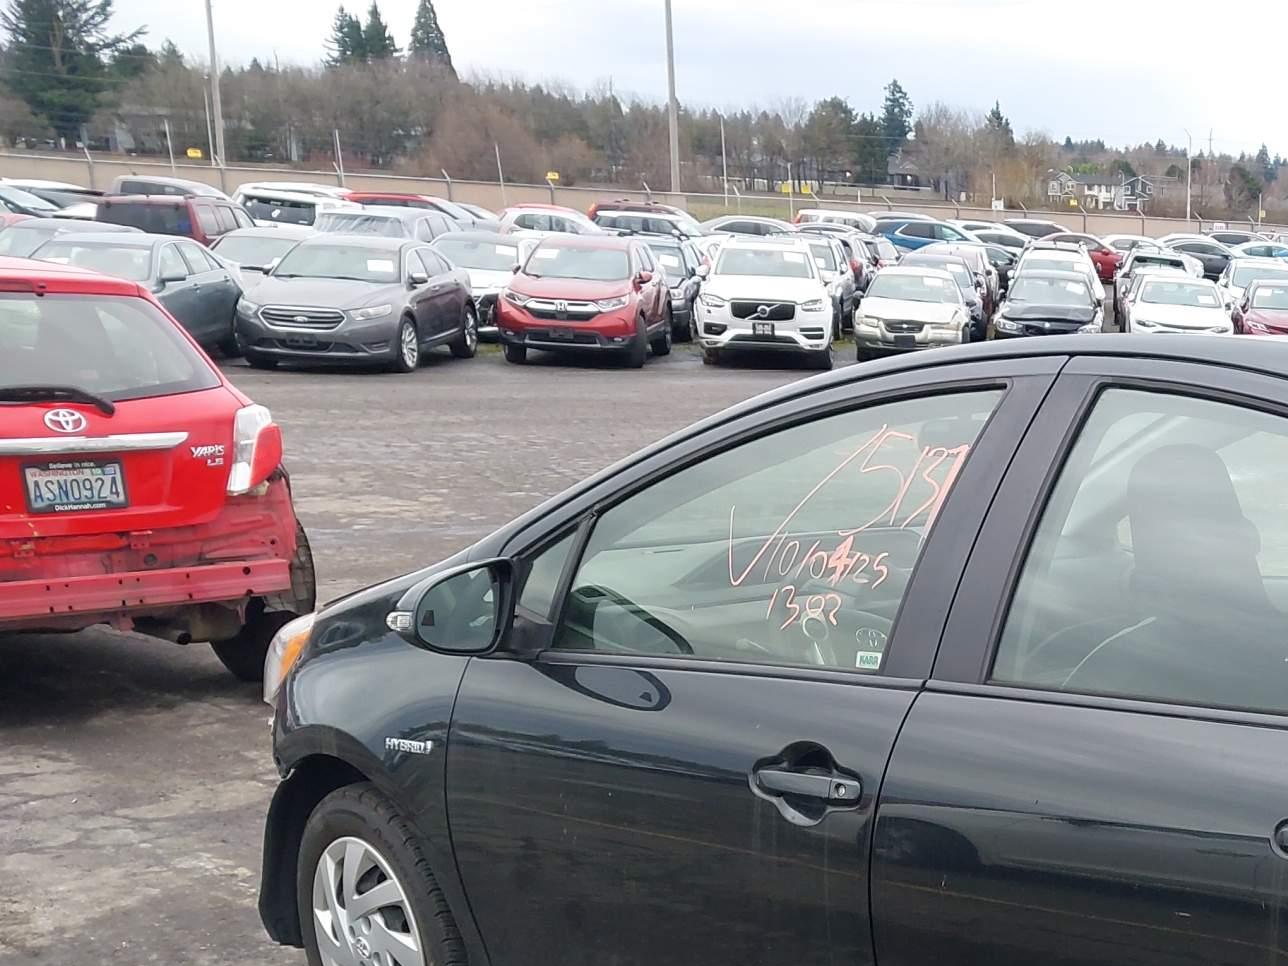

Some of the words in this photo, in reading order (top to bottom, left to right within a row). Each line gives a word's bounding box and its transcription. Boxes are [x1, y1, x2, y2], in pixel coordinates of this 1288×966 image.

[190, 444, 225, 458] YARIS
[207, 457, 224, 466] LE
[33, 476, 120, 503] ASN0924
[385, 737, 426, 754] HYBRID
